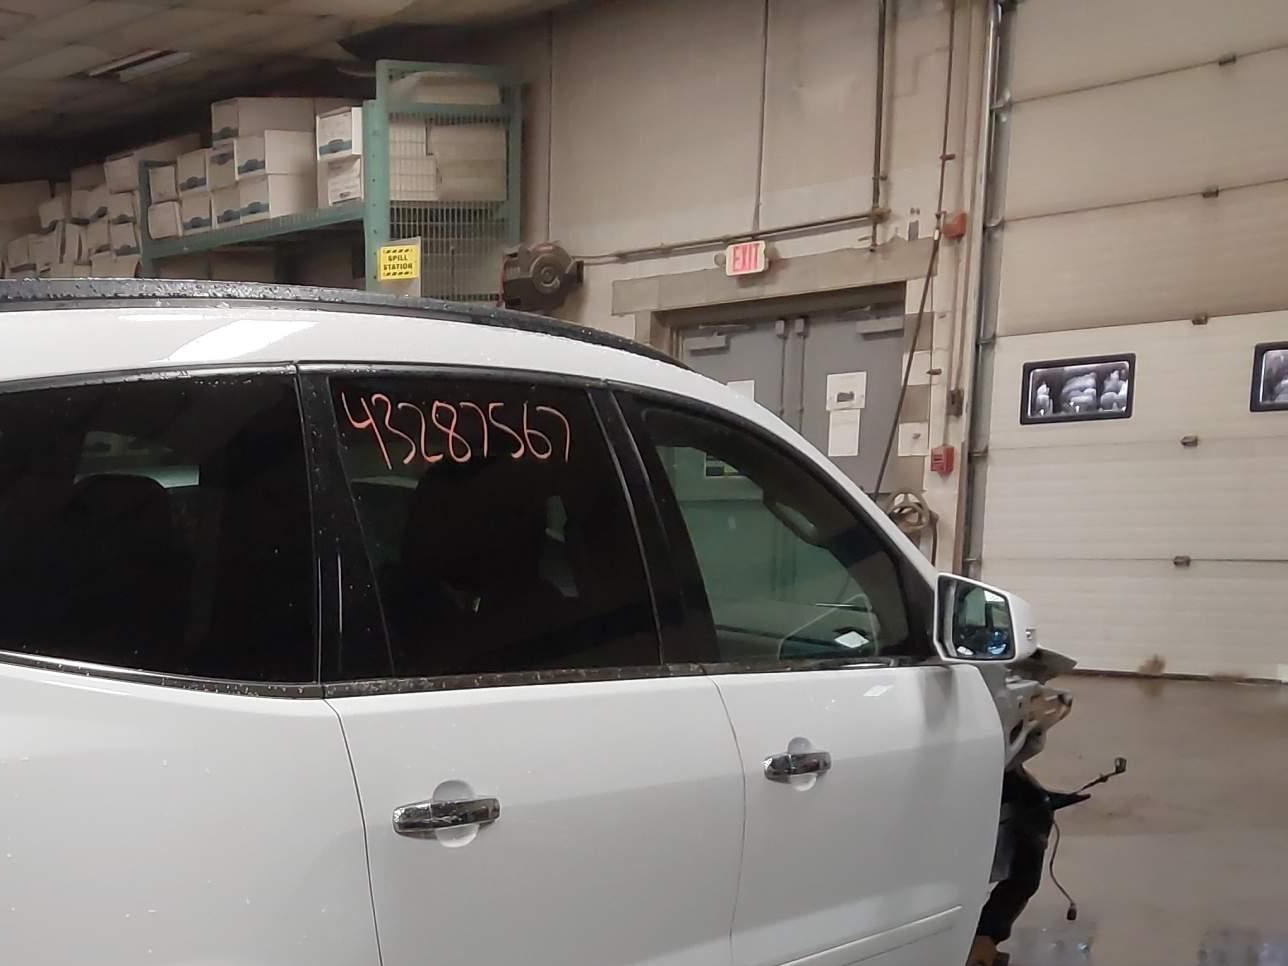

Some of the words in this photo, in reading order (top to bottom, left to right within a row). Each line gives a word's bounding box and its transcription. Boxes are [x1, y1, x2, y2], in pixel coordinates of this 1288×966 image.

[383, 262, 413, 271] STATION
[387, 254, 409, 262] SPILL
[732, 242, 761, 273] EXIT
[341, 391, 571, 470] 43287567
